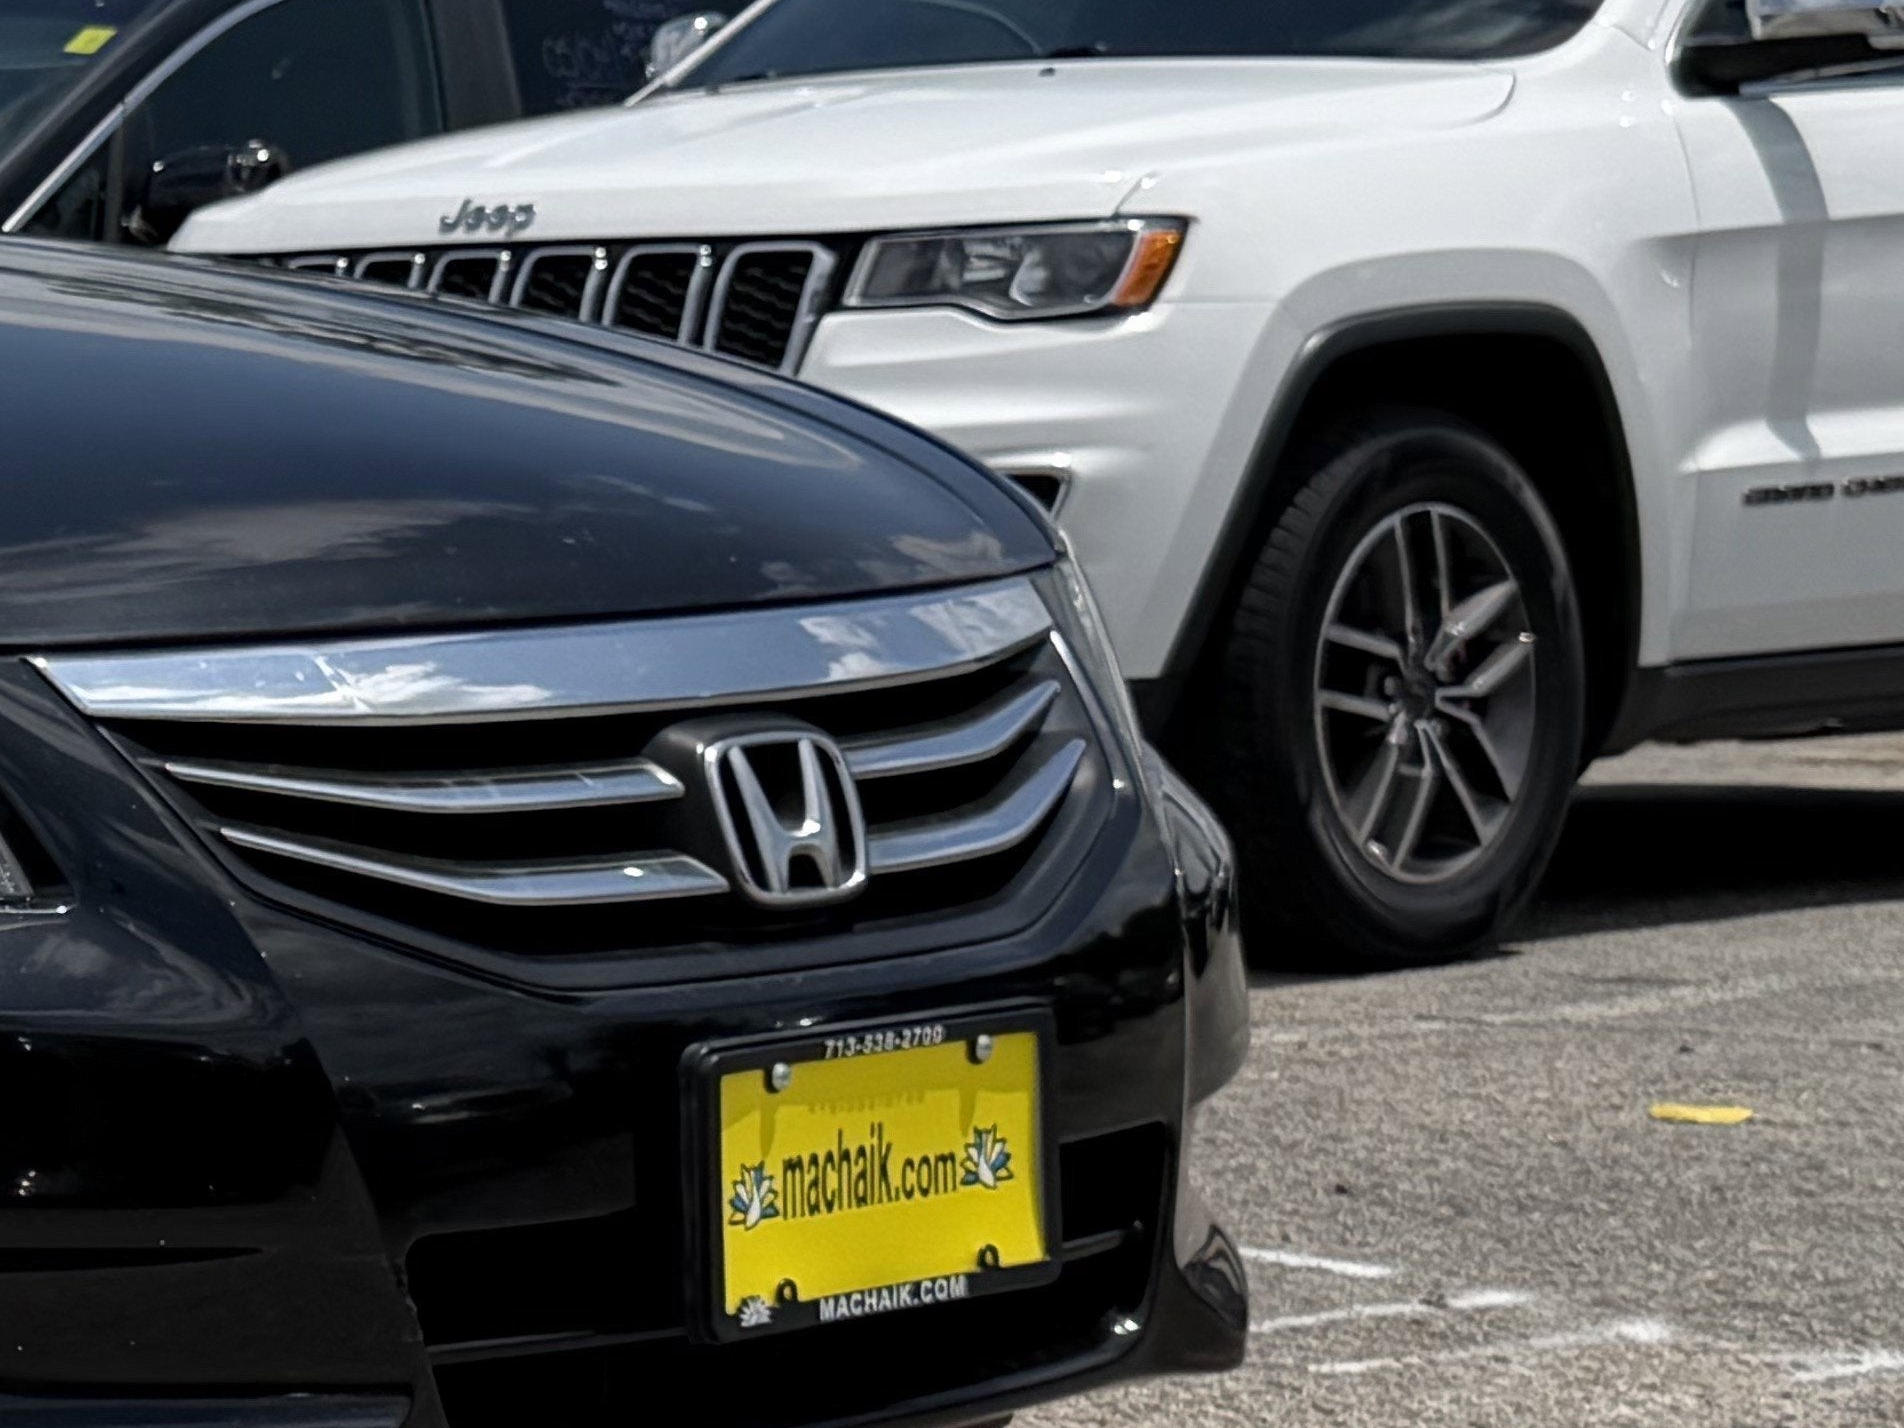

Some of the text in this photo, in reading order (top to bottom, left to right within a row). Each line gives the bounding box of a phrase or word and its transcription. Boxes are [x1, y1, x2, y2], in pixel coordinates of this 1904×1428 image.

[438, 196, 536, 240] Jeep
[782, 1122, 957, 1220] machaik.com
[818, 1274, 967, 1322] MACHAIK.COM
